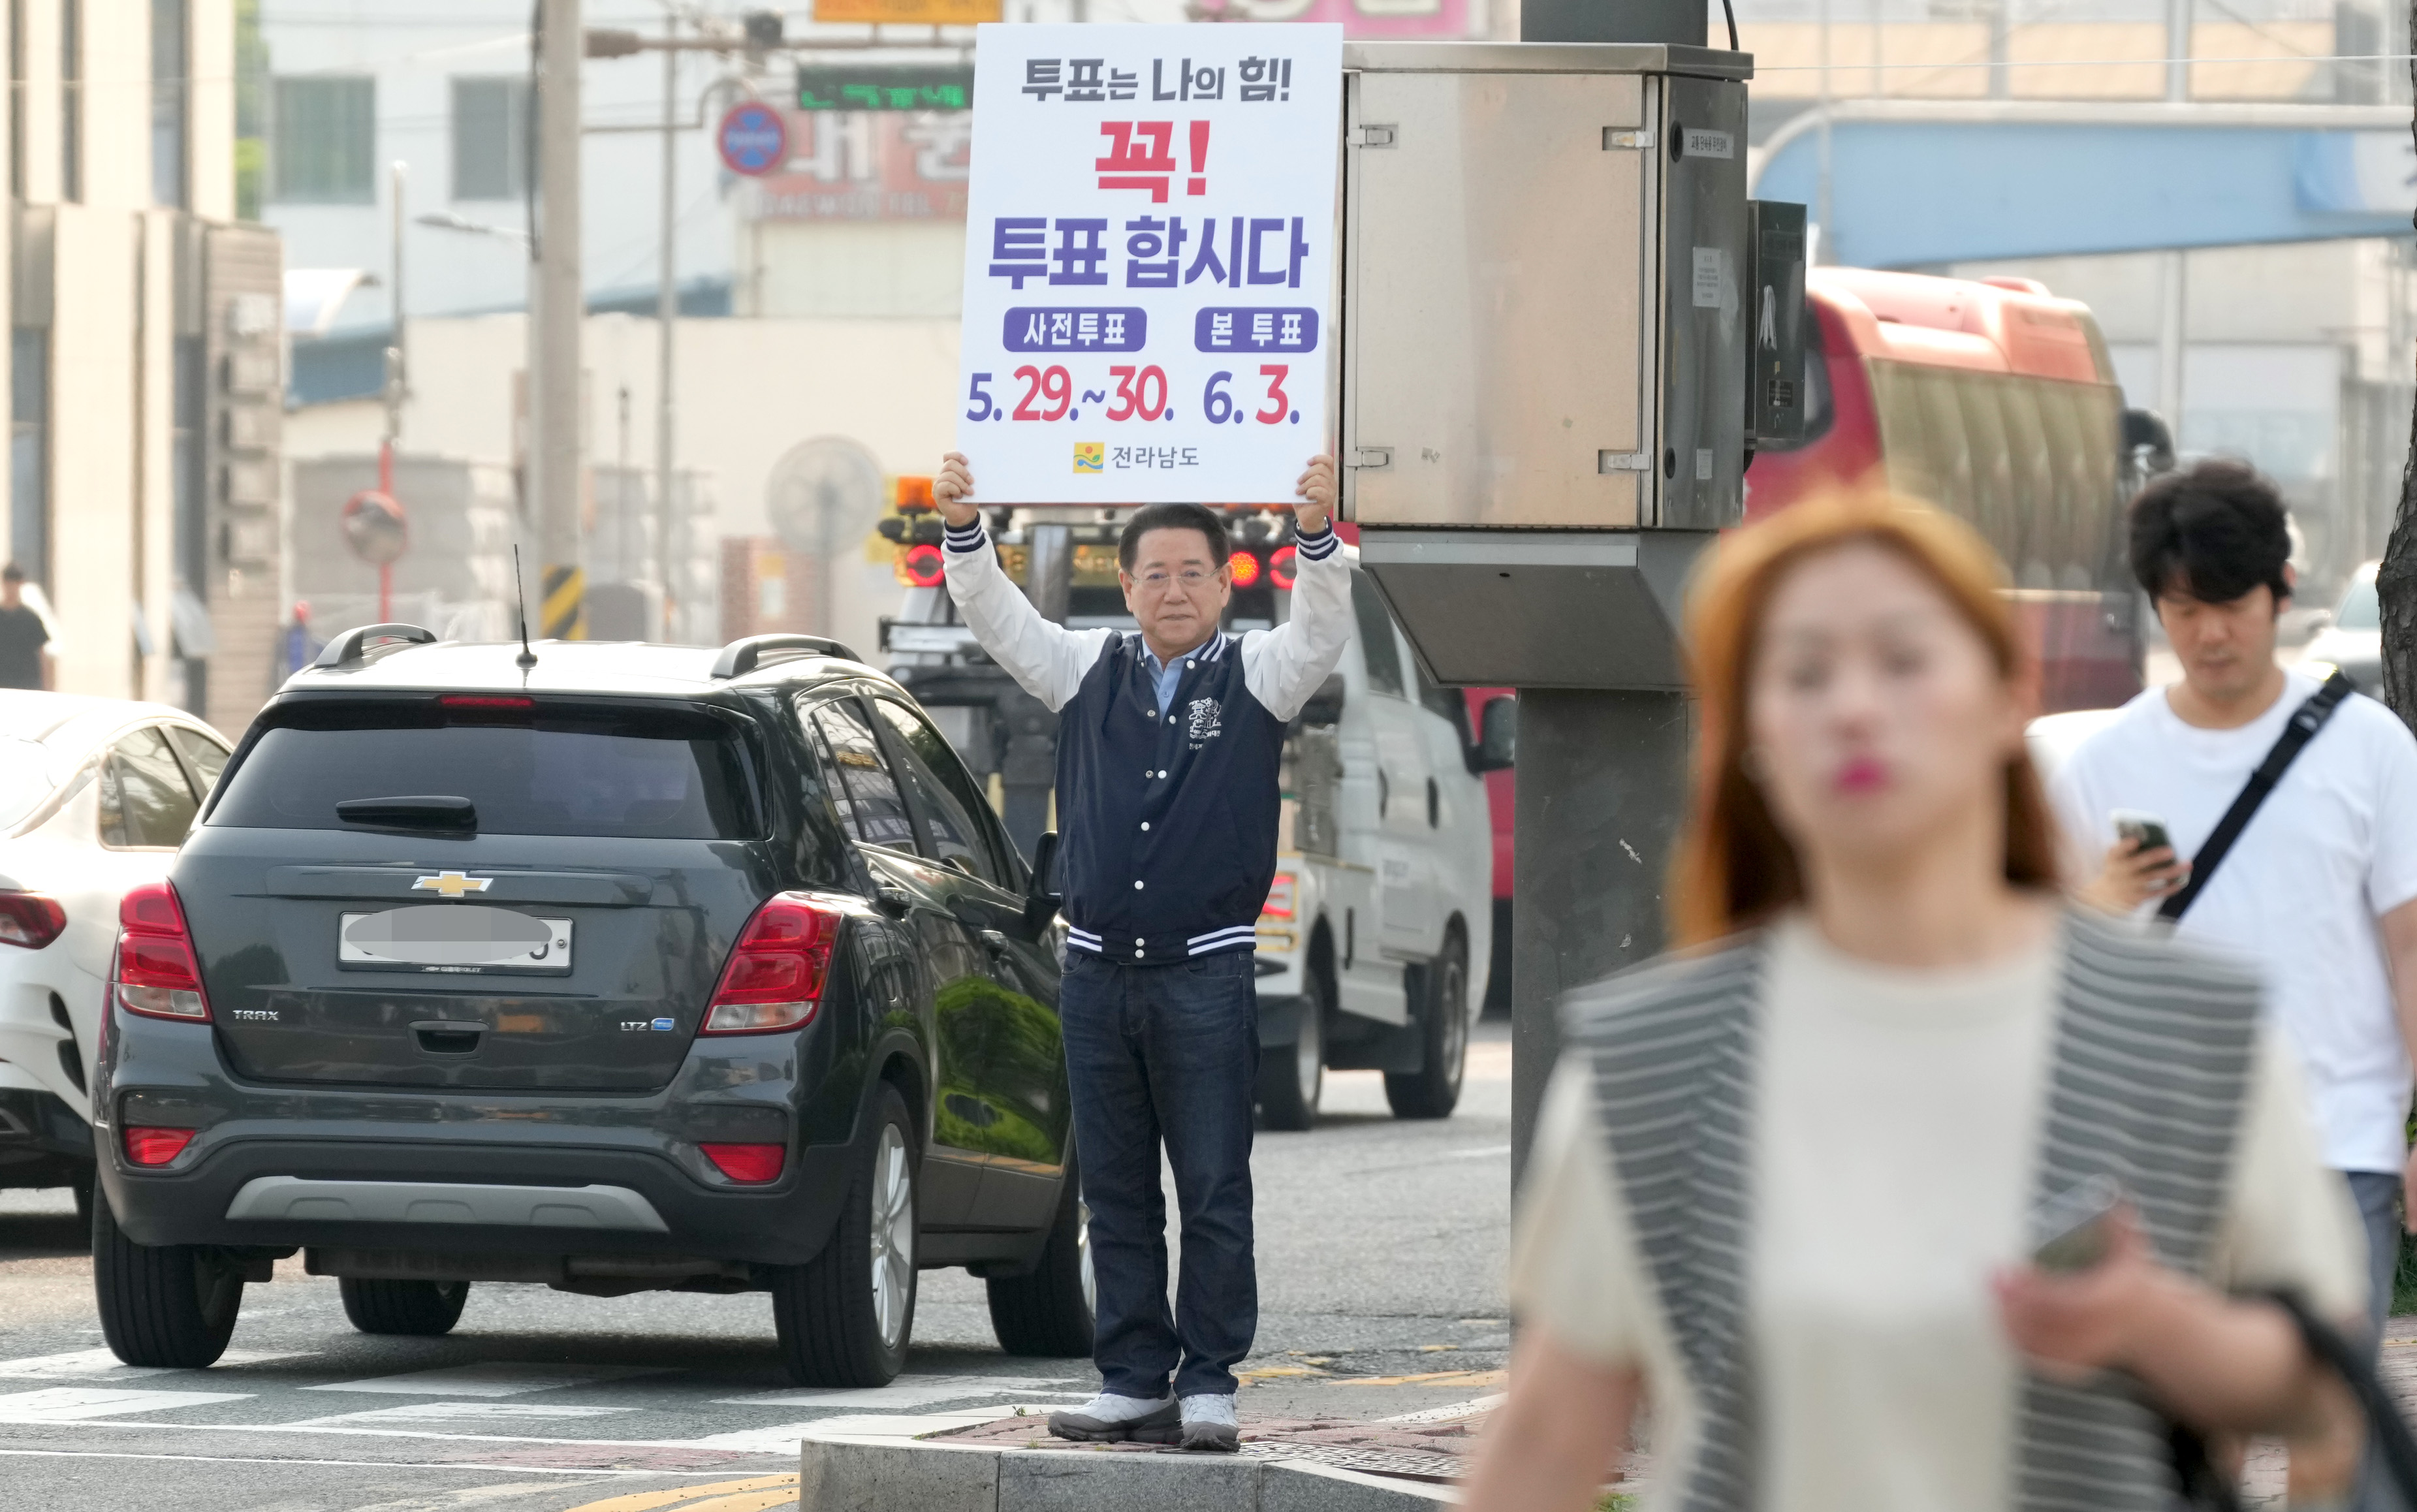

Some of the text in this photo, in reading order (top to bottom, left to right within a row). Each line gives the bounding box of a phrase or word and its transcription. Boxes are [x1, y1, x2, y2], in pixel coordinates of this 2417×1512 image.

[1022, 56, 1293, 102] 투표는 나의 힘!
[1096, 121, 1211, 204] 꼭!
[989, 215, 1310, 290] 투표 합시다
[1024, 313, 1126, 347] 사전투표
[1111, 447, 1200, 469] 전라남도
[232, 1010, 279, 1020] TRAX
[621, 1022, 647, 1031] LTZ
